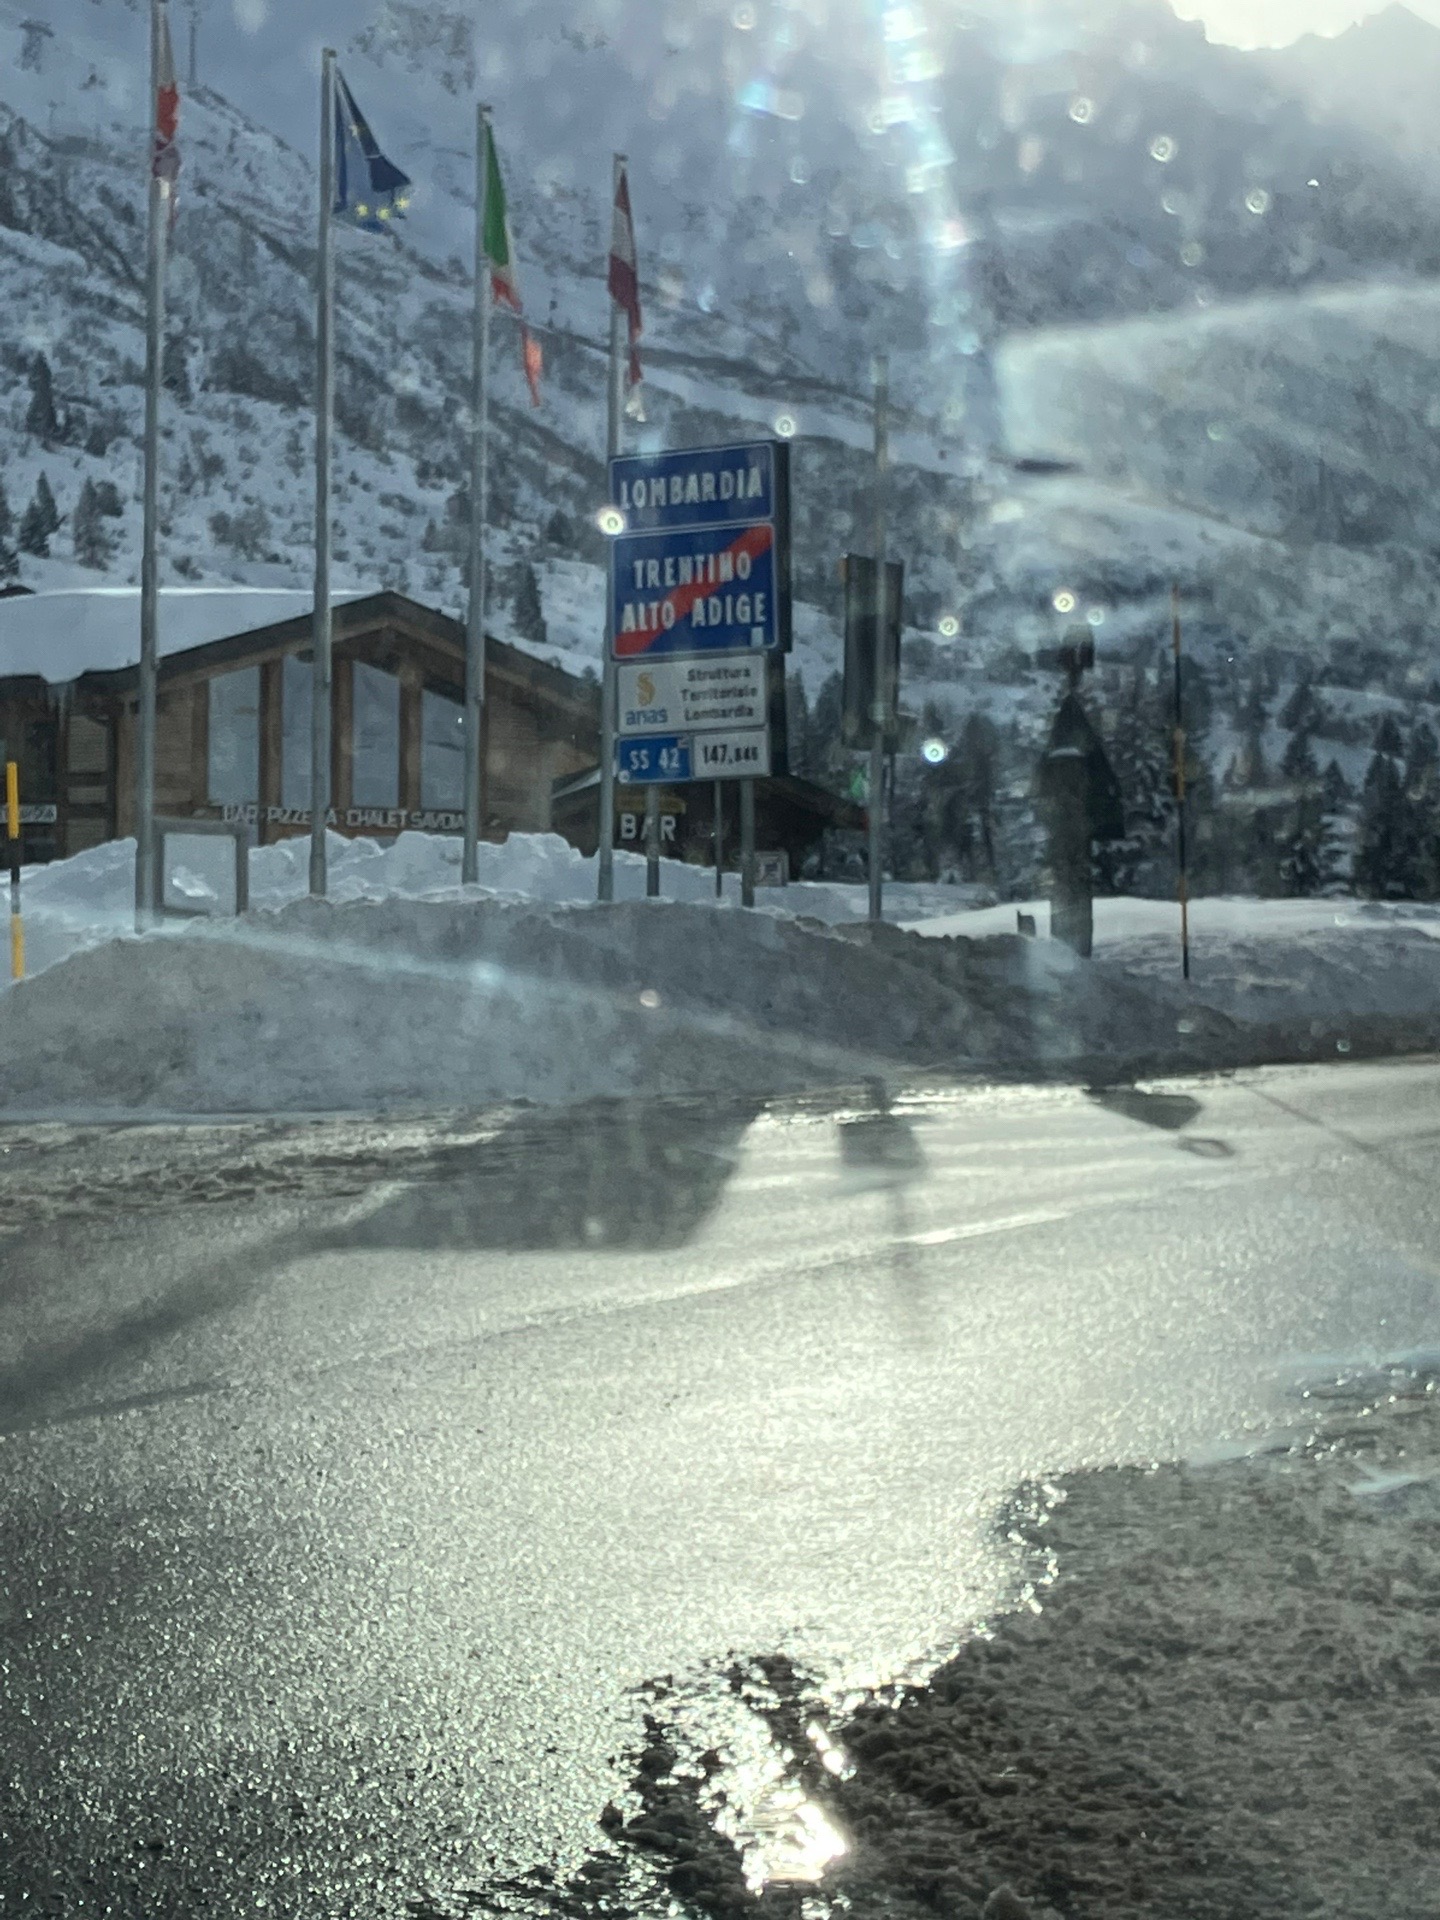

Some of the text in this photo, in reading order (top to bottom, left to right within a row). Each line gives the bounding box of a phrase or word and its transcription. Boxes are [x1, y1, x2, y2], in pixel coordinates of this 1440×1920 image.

[620, 467, 763, 509] LOMBARDIA
[634, 551, 751, 589] TRENTINO
[621, 592, 767, 632] ALTO ADIGE
[625, 709, 668, 726] anas
[629, 748, 680, 770] SS 42
[267, 806, 338, 825] PIZZEA
[346, 809, 408, 828] CHALET
